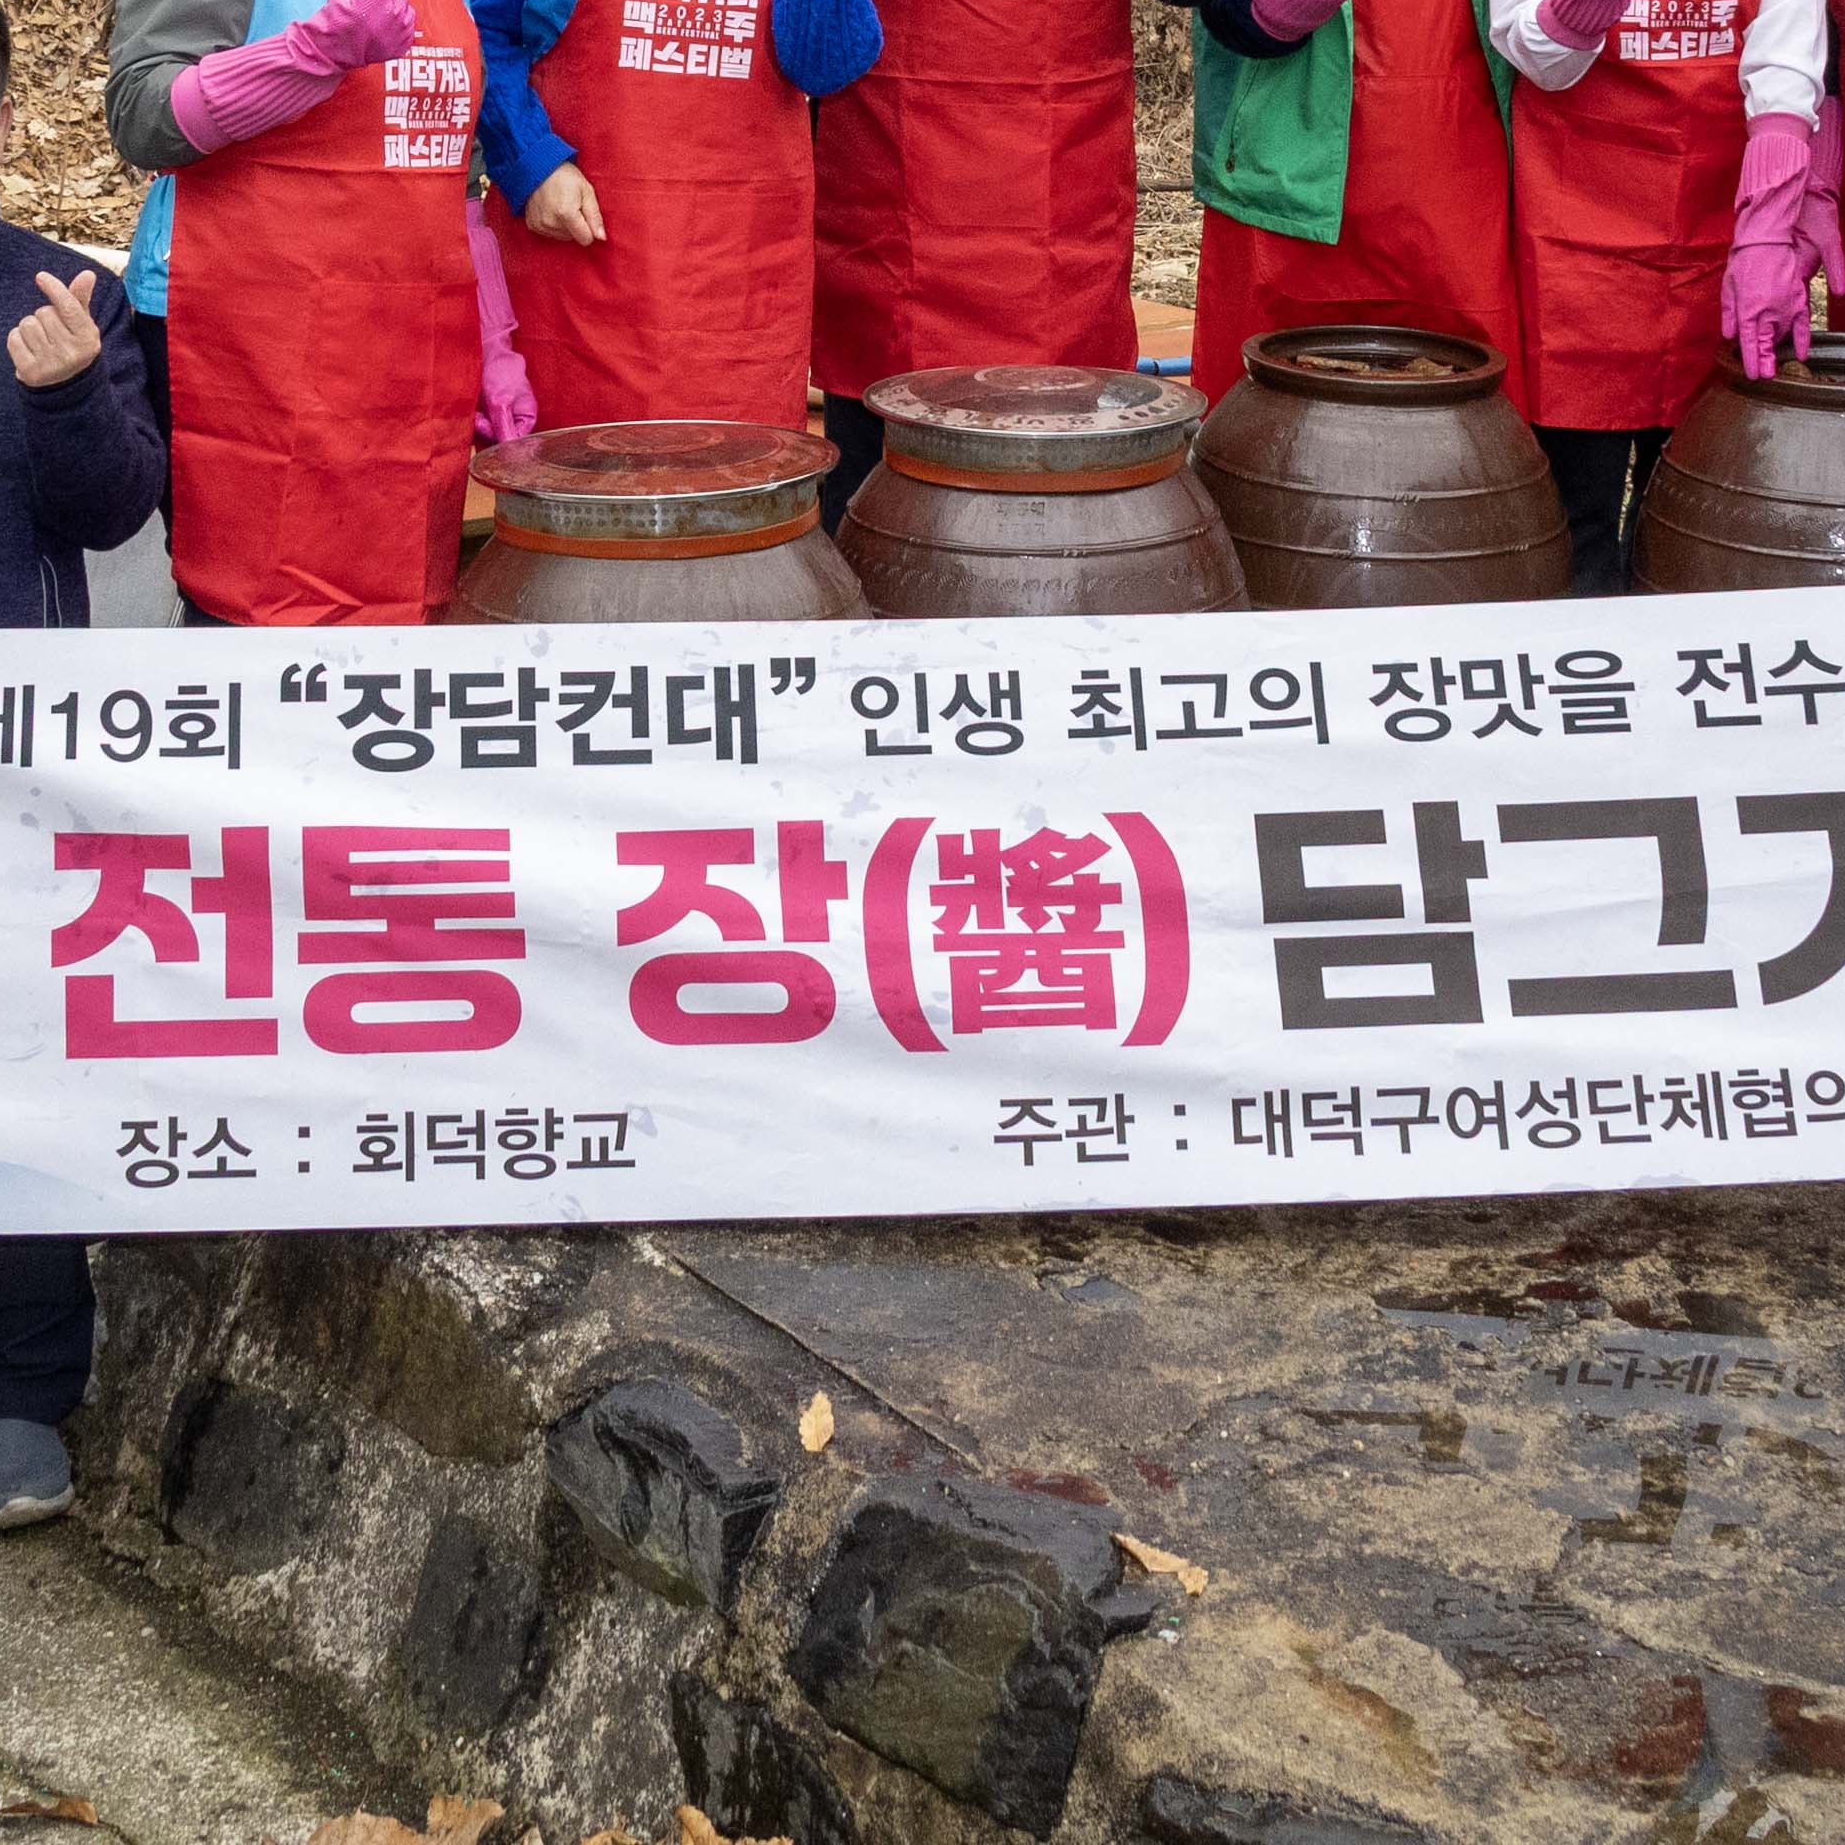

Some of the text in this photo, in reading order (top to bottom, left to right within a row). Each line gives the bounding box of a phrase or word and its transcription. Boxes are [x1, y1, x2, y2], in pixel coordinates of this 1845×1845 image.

[658, 4, 722, 22] 2023
[1651, 0, 1710, 12] 2023
[618, 36, 752, 79] 페스티벌
[1619, 27, 1735, 60] 페스티벌
[385, 58, 470, 93] 대덕거리
[409, 97, 453, 111] 2023
[384, 134, 468, 167] 페스티벌
[280, 657, 816, 773] “장담컨대”
[849, 670, 1025, 758] 인생
[1066, 660, 1331, 752] 최고의
[1368, 649, 1637, 743] 장맛을
[50, 825, 527, 1060] 전통
[615, 811, 1191, 1054] 장(醬)
[992, 1093, 1136, 1166] 주관
[115, 1116, 258, 1189] 장소
[351, 1106, 637, 1182] 회덕향교
